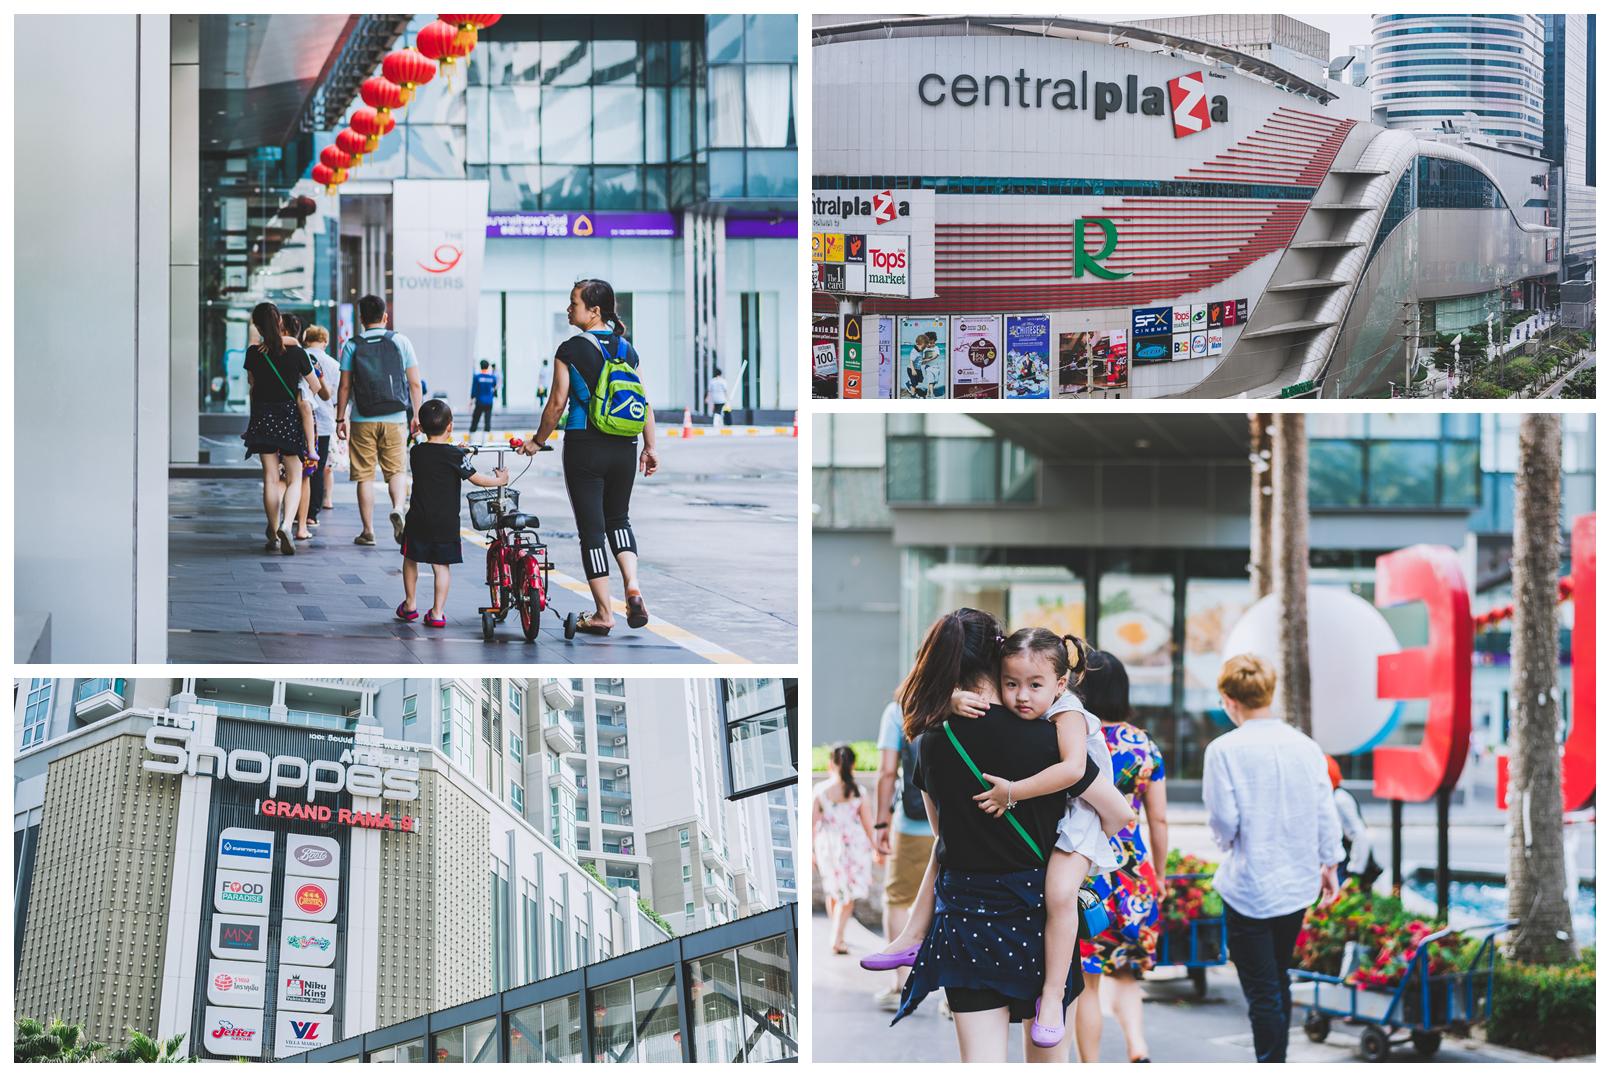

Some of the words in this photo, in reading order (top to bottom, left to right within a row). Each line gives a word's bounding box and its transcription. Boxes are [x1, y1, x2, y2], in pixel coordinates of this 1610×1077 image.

[445, 232, 464, 240] THE
[1073, 219, 1135, 280] R
[869, 249, 906, 273] Tops
[398, 276, 464, 289] TOWERS
[827, 274, 837, 282] The
[827, 278, 844, 290] card
[868, 273, 906, 285] market
[1135, 309, 1169, 327] SFX
[1174, 312, 1189, 323] Tops
[1174, 341, 1189, 352] B2S
[262, 799, 331, 823] GRAND
[338, 807, 392, 830] RAMA
[401, 816, 413, 832] 9
[222, 880, 263, 895] FOOD
[222, 893, 263, 903] PARADISE
[304, 981, 327, 990] Niku
[304, 988, 326, 999] King
[212, 1026, 256, 1039] Jeffer
